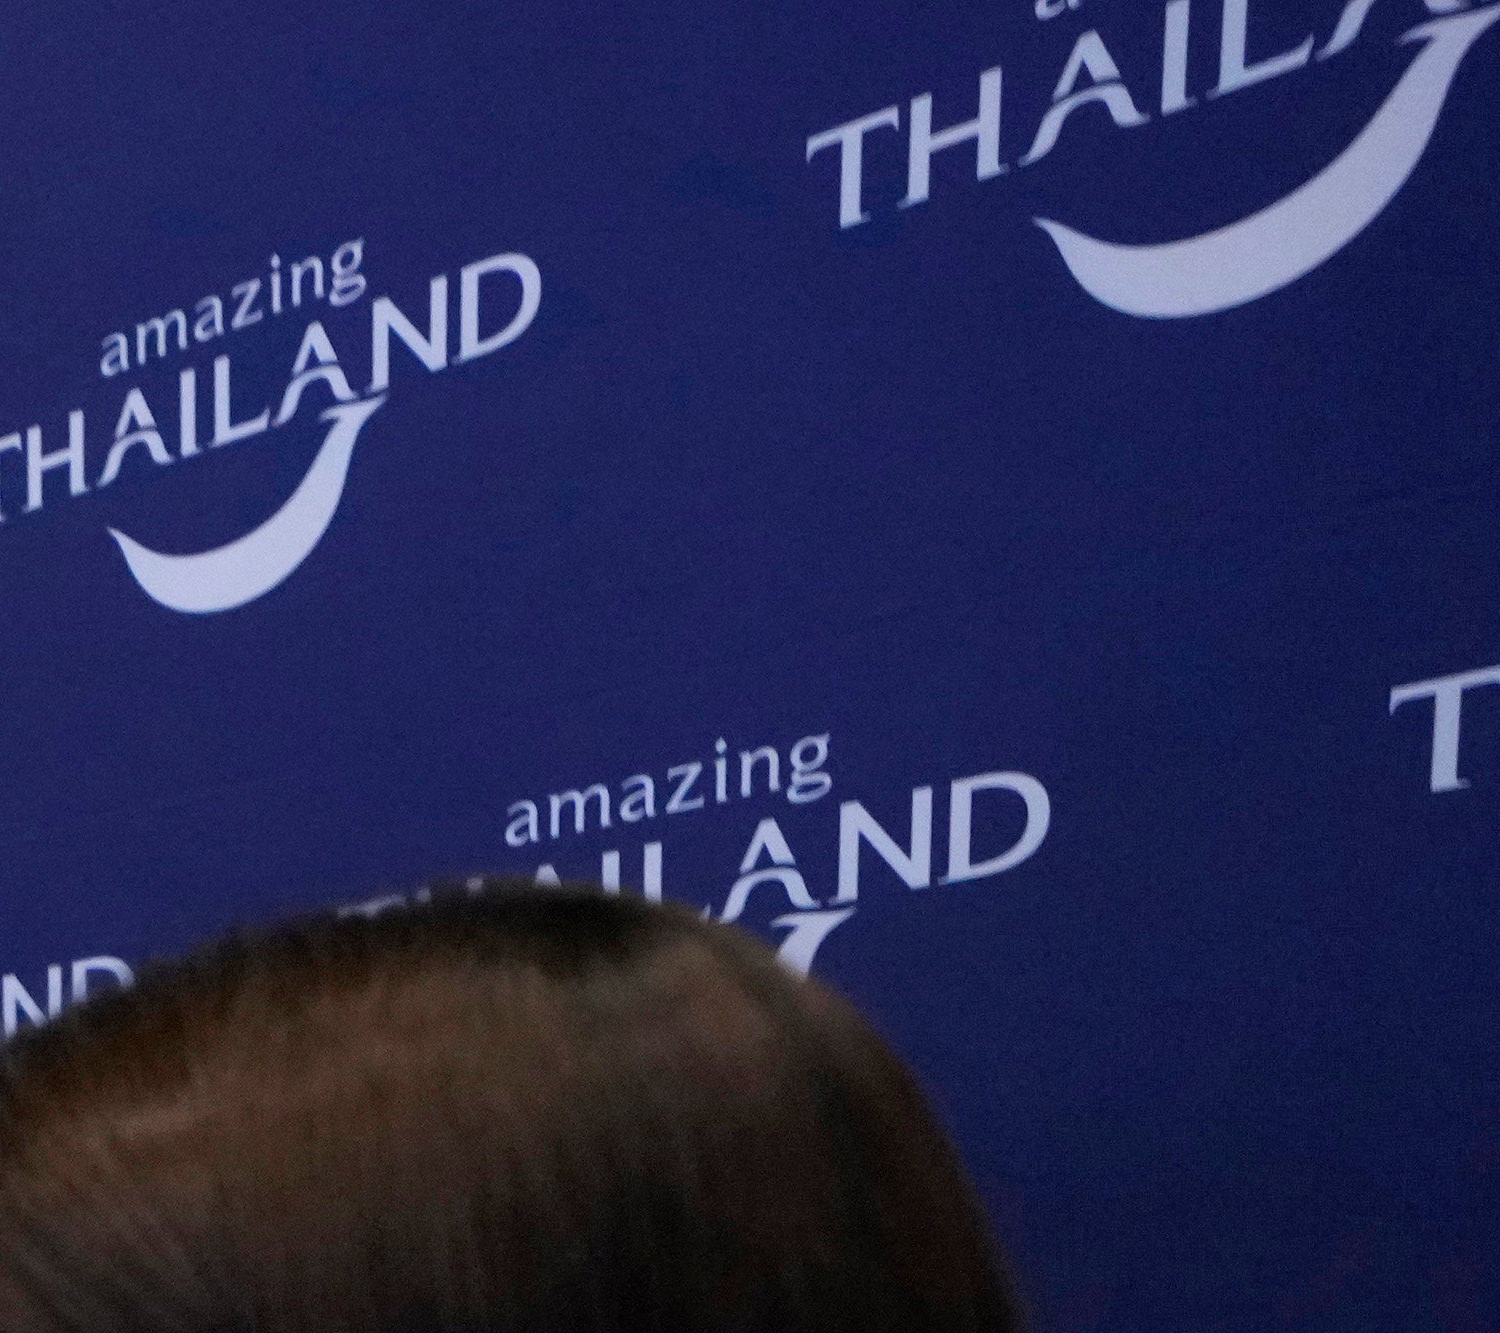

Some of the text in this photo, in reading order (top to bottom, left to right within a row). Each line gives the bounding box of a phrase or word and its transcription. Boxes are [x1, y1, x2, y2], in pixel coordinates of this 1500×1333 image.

[806, 0, 1462, 228] THAIL
[101, 239, 367, 376] amazing
[505, 733, 832, 846] amazing
